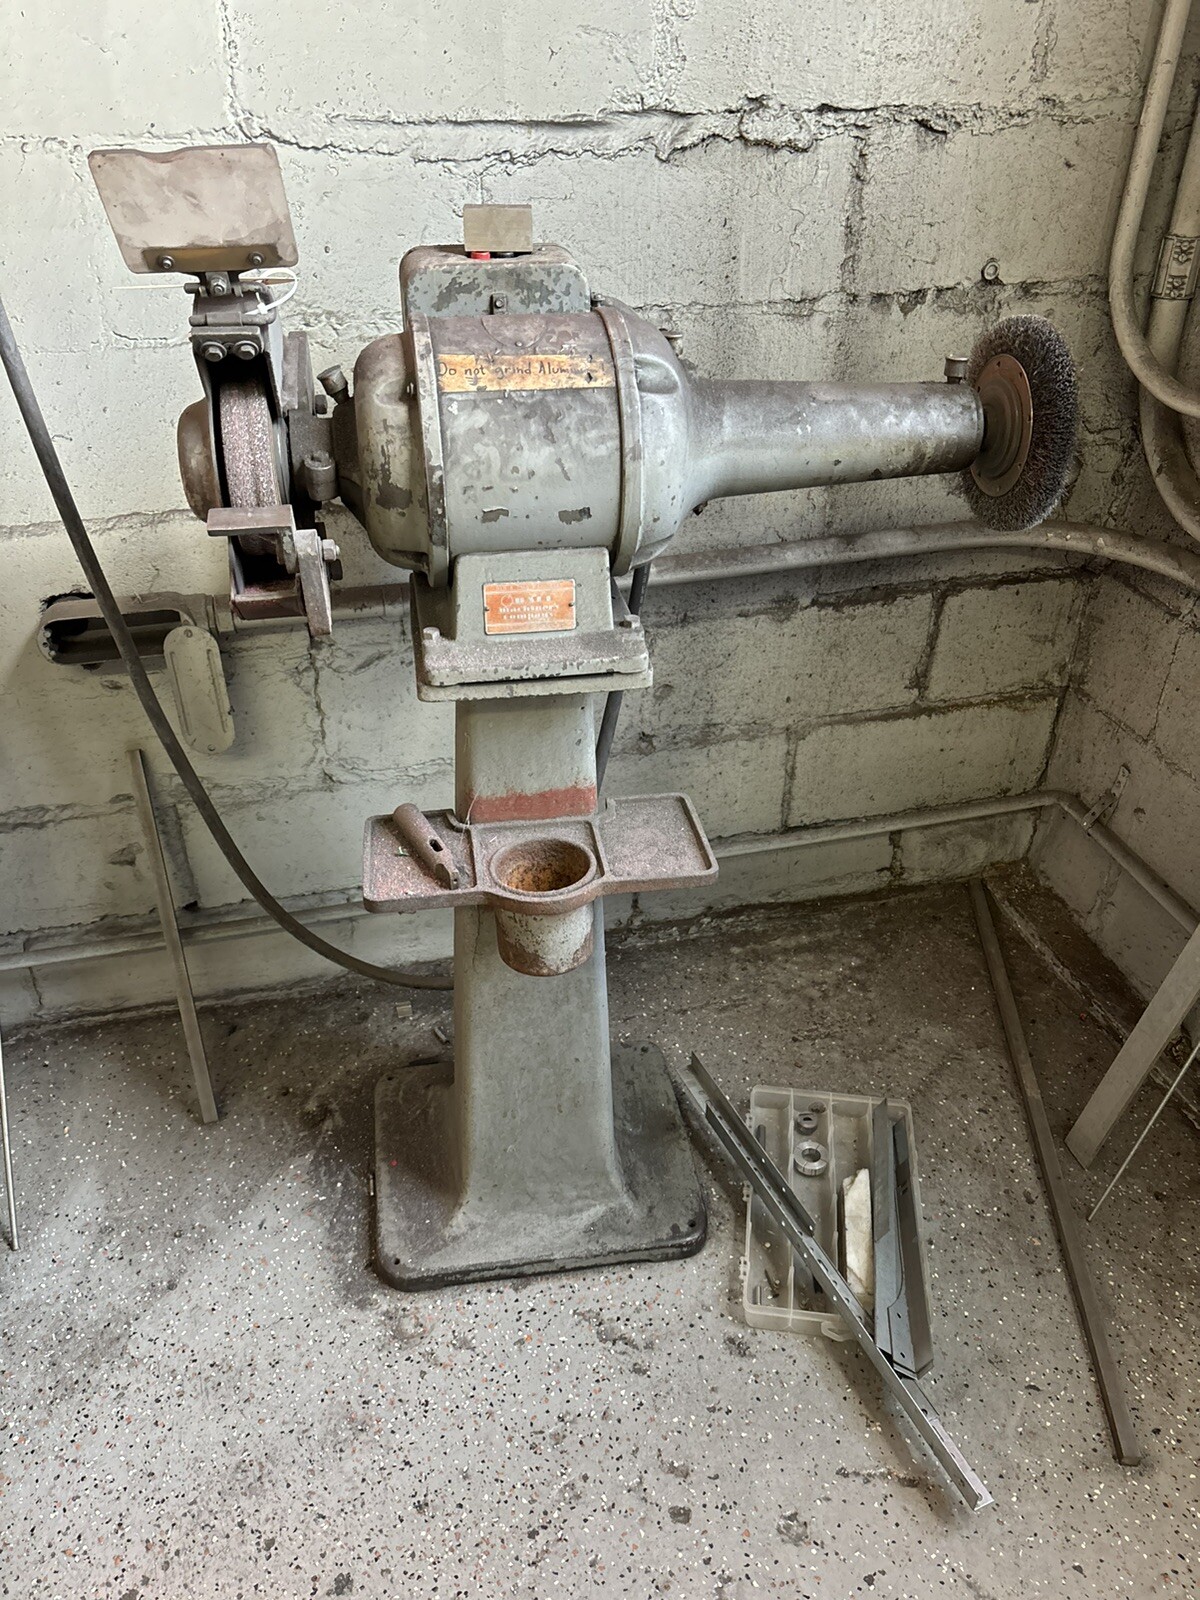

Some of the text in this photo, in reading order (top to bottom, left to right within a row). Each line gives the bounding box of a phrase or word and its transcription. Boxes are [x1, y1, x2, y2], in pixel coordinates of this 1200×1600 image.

[438, 361, 457, 376] Do
[464, 365, 486, 376] not
[494, 361, 532, 380] grind
